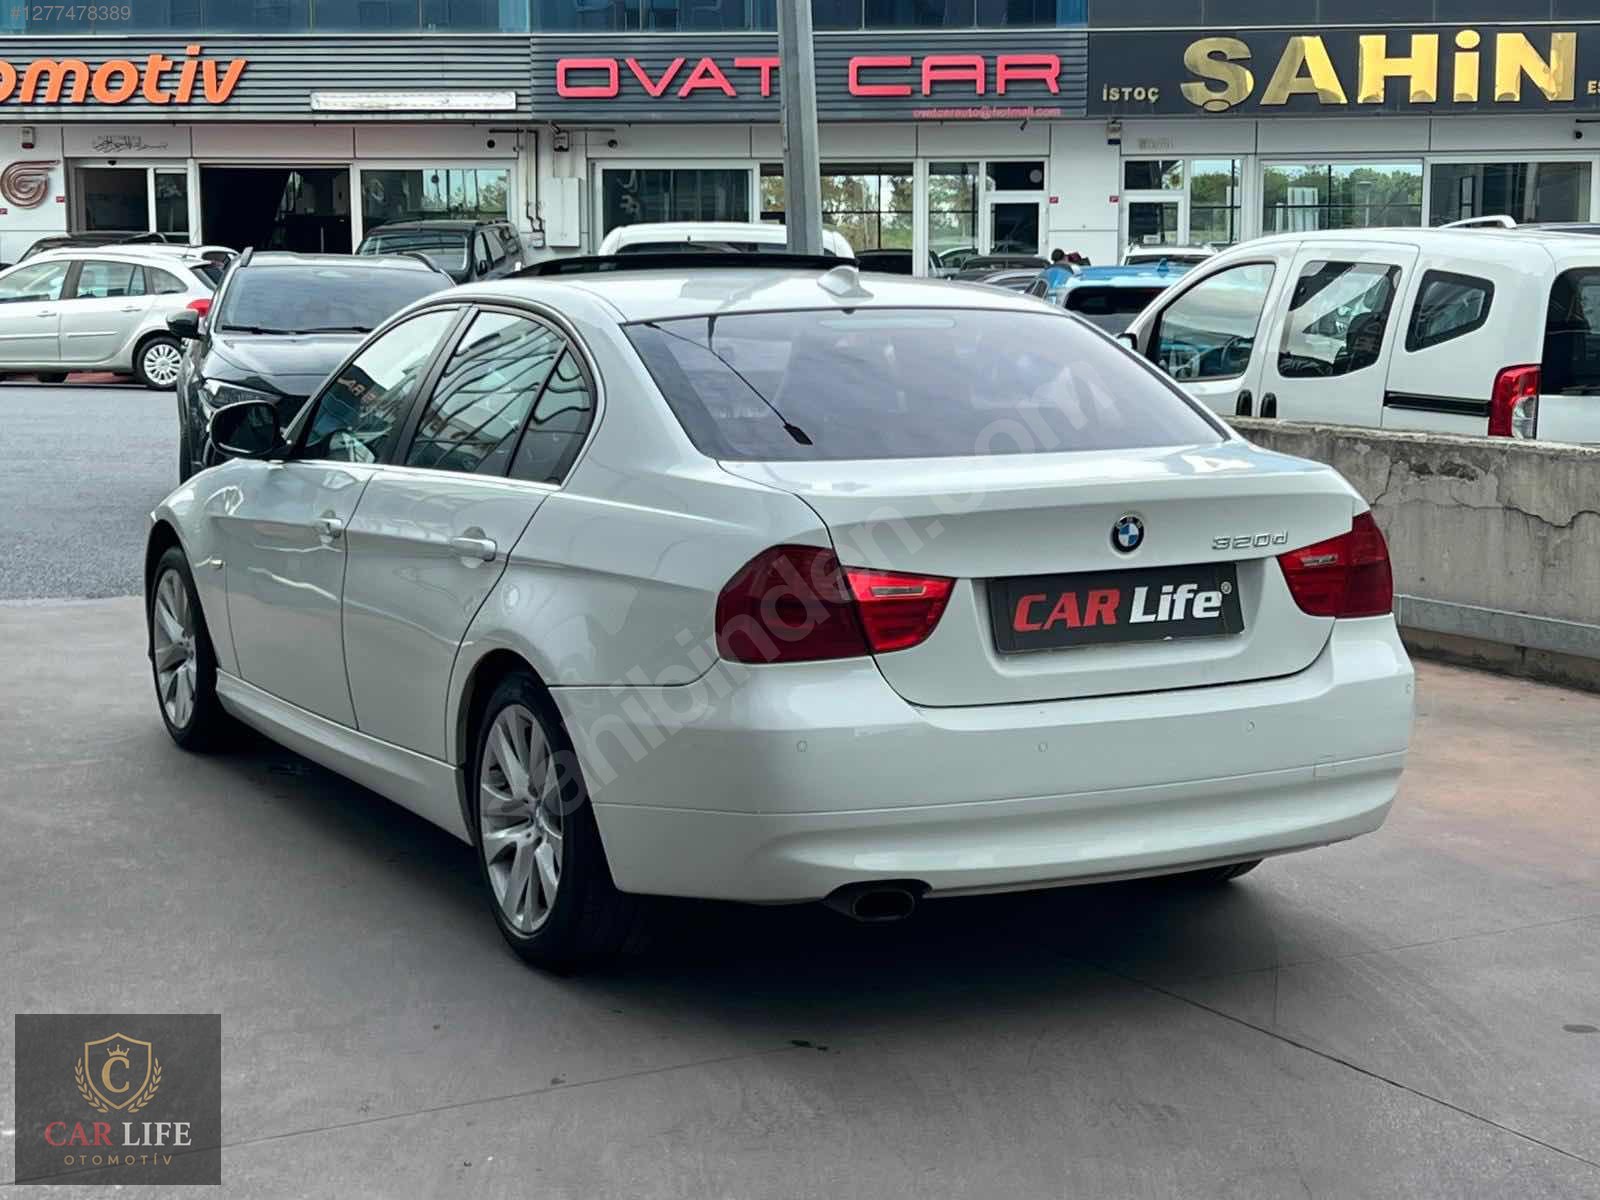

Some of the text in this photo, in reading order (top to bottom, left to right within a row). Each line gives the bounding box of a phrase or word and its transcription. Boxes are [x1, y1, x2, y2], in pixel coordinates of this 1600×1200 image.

[848, 54, 1061, 97] CAR
[1212, 530, 1289, 551] 320d
[1012, 588, 1121, 633] CAR
